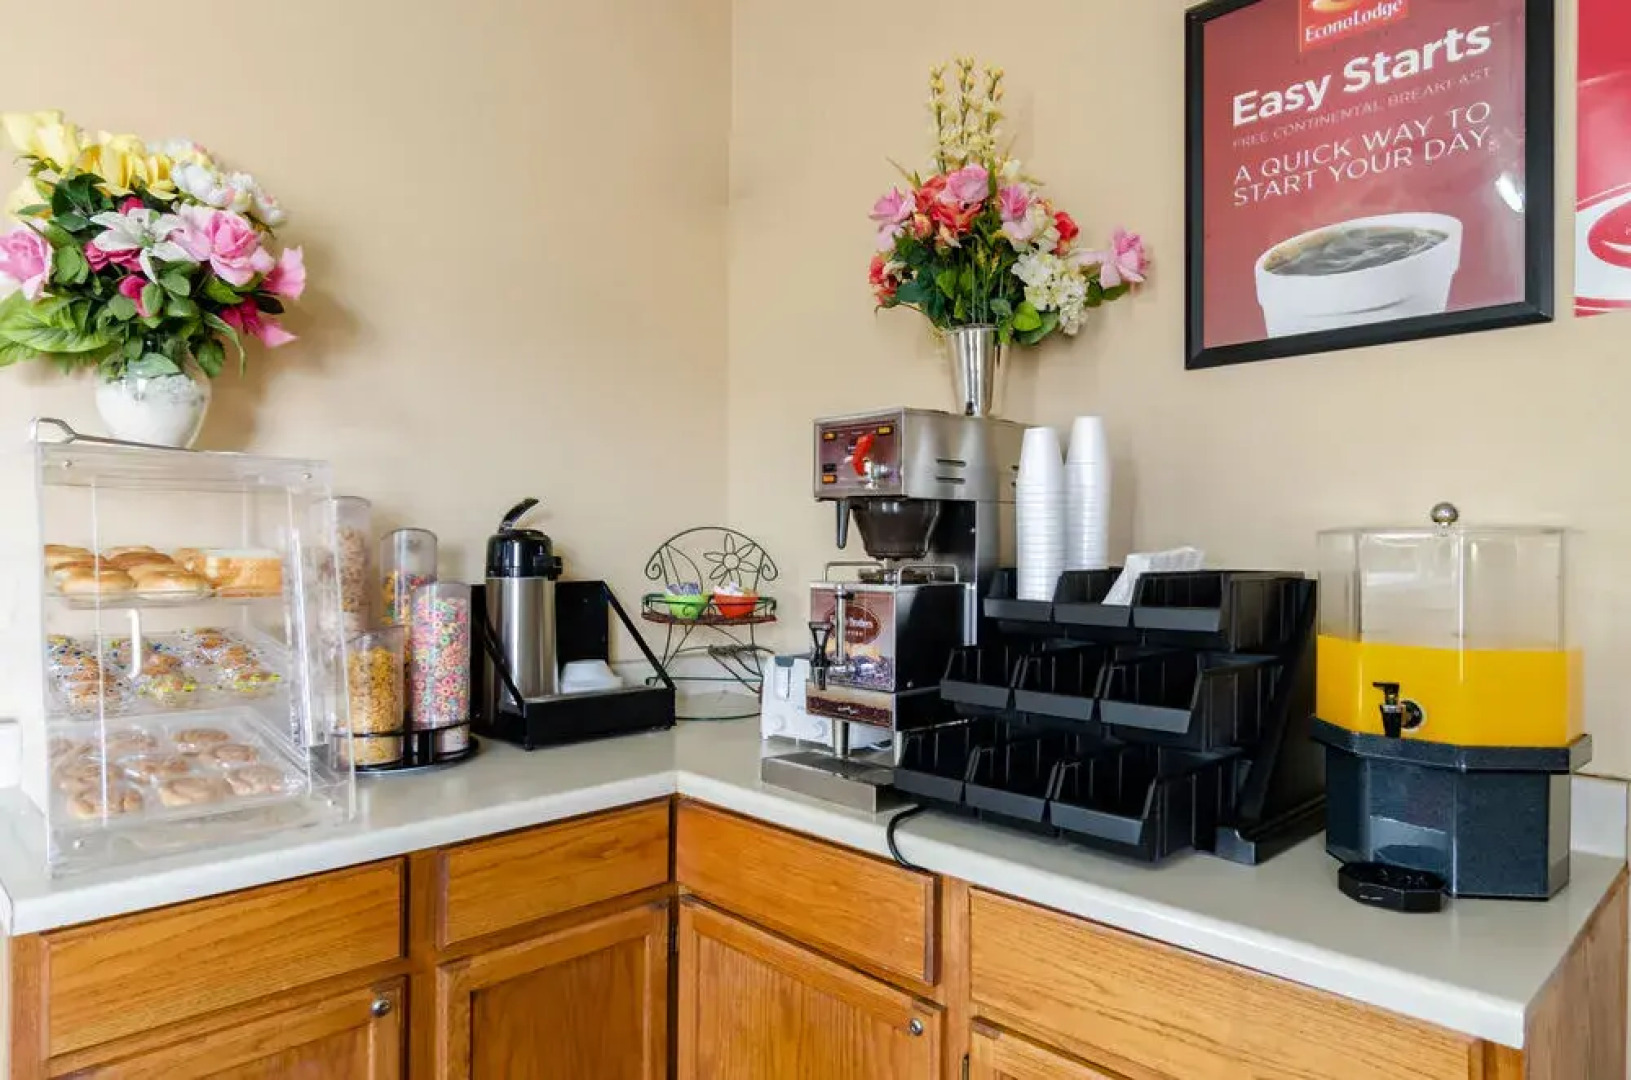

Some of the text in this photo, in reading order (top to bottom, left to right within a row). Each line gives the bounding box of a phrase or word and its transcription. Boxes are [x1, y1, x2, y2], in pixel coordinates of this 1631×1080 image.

[1232, 66, 1491, 149] FREE CONTINENTAL BREAKFAST
[1233, 25, 1492, 127] Easy Starts
[1234, 101, 1491, 185] A QUICK WAY TO
[1234, 169, 1317, 206] START
[1329, 146, 1413, 183] YOUR
